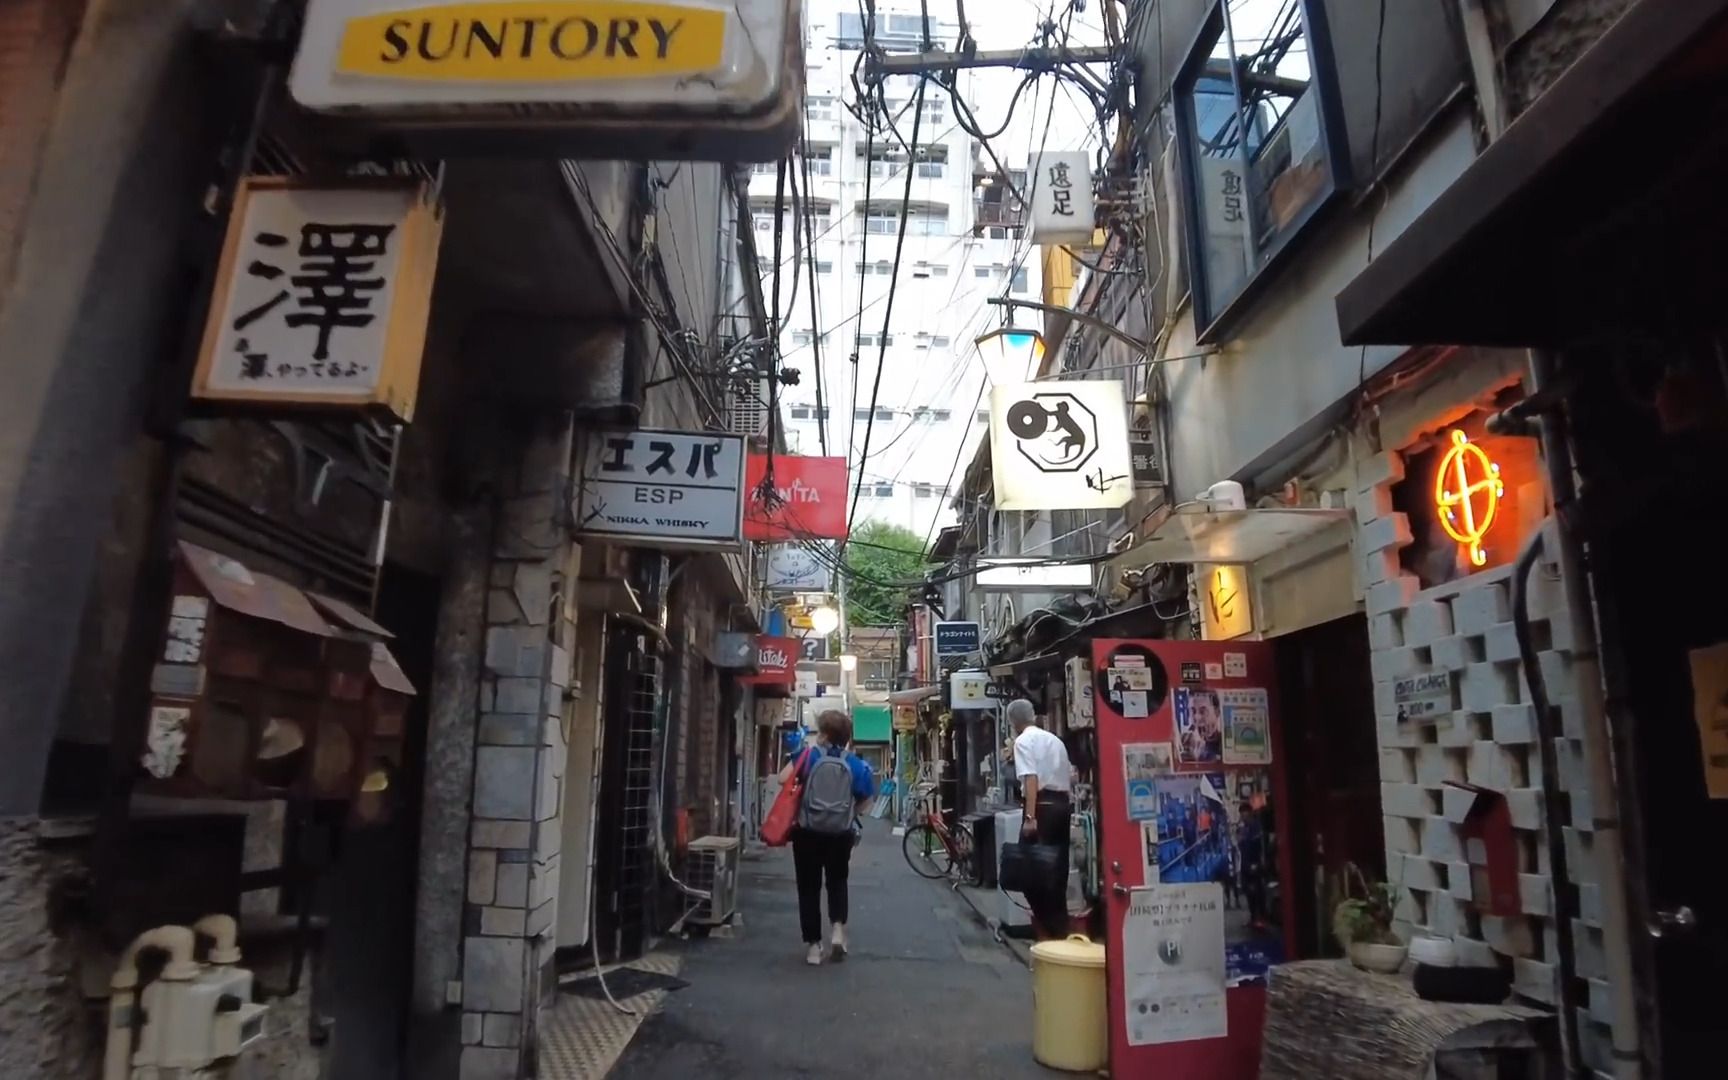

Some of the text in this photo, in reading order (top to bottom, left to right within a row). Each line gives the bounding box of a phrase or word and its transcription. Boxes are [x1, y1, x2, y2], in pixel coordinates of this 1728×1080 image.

[380, 18, 684, 64] SUNTORY
[1048, 161, 1074, 217] 遠足
[233, 223, 397, 361] 澤
[602, 438, 721, 480] エスパ
[634, 487, 684, 505] ESP
[606, 515, 709, 529] NIKKA WHISKY
